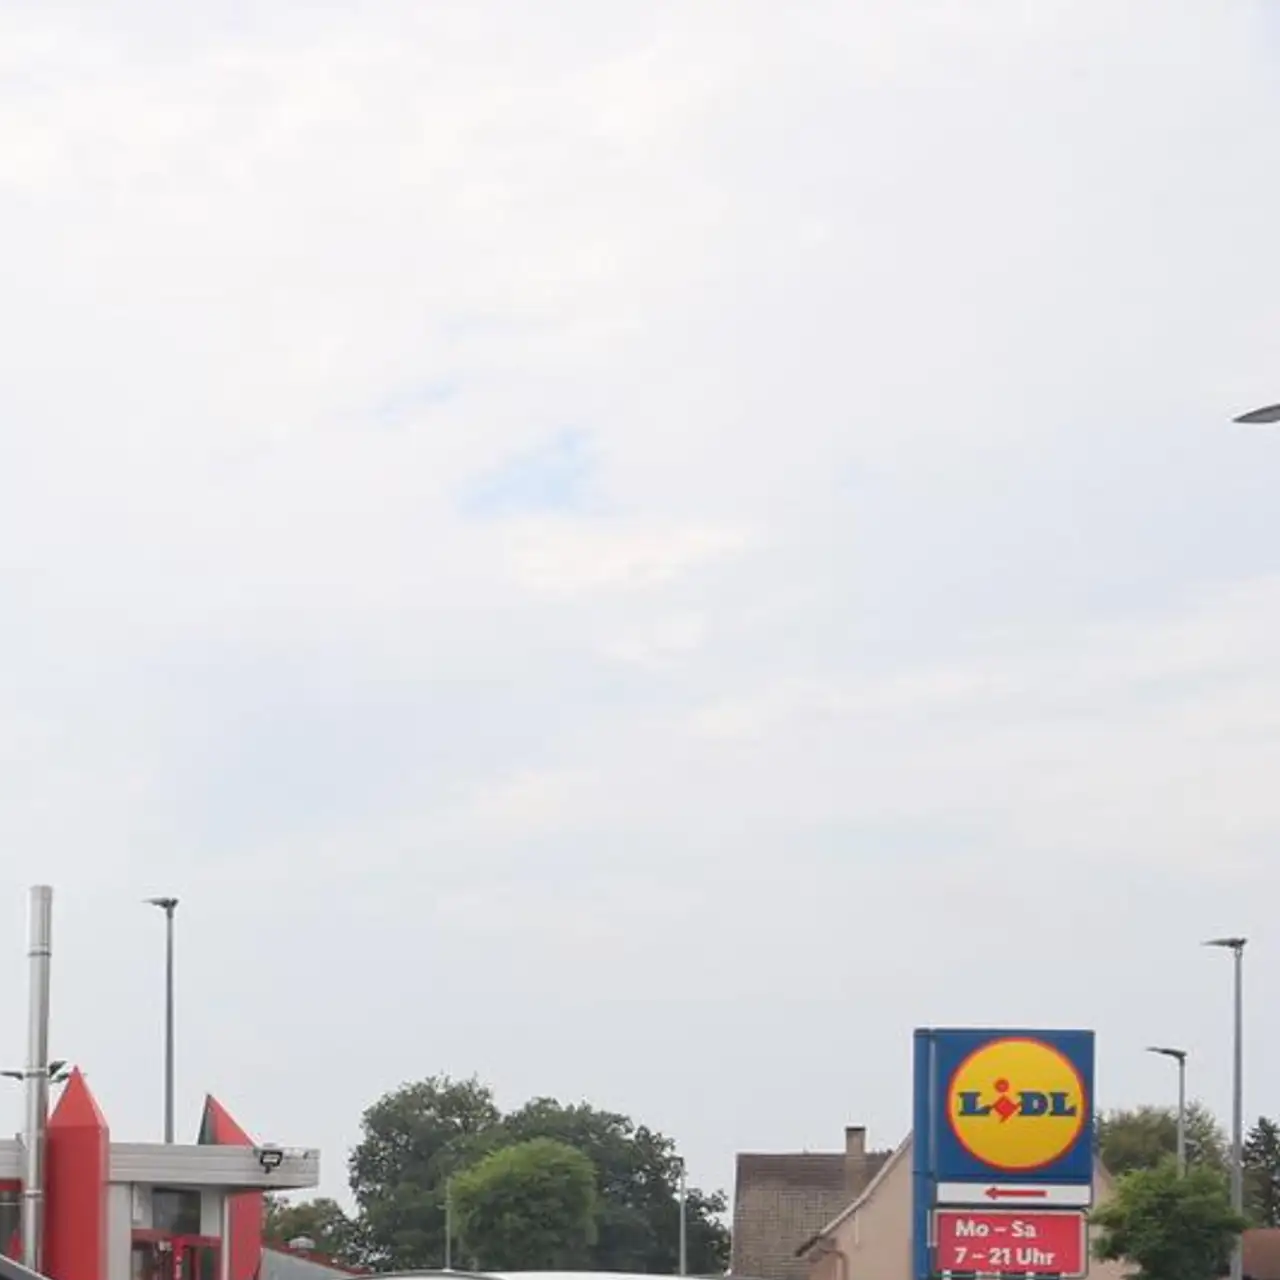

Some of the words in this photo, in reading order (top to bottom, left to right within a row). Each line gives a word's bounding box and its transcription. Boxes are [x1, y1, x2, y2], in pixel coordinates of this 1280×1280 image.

[955, 1219, 989, 1237] Mo
[1011, 1220, 1037, 1238] Sa
[954, 1247, 968, 1264] 7
[989, 1247, 1011, 1265] 21
[1016, 1247, 1056, 1265] Uhr
